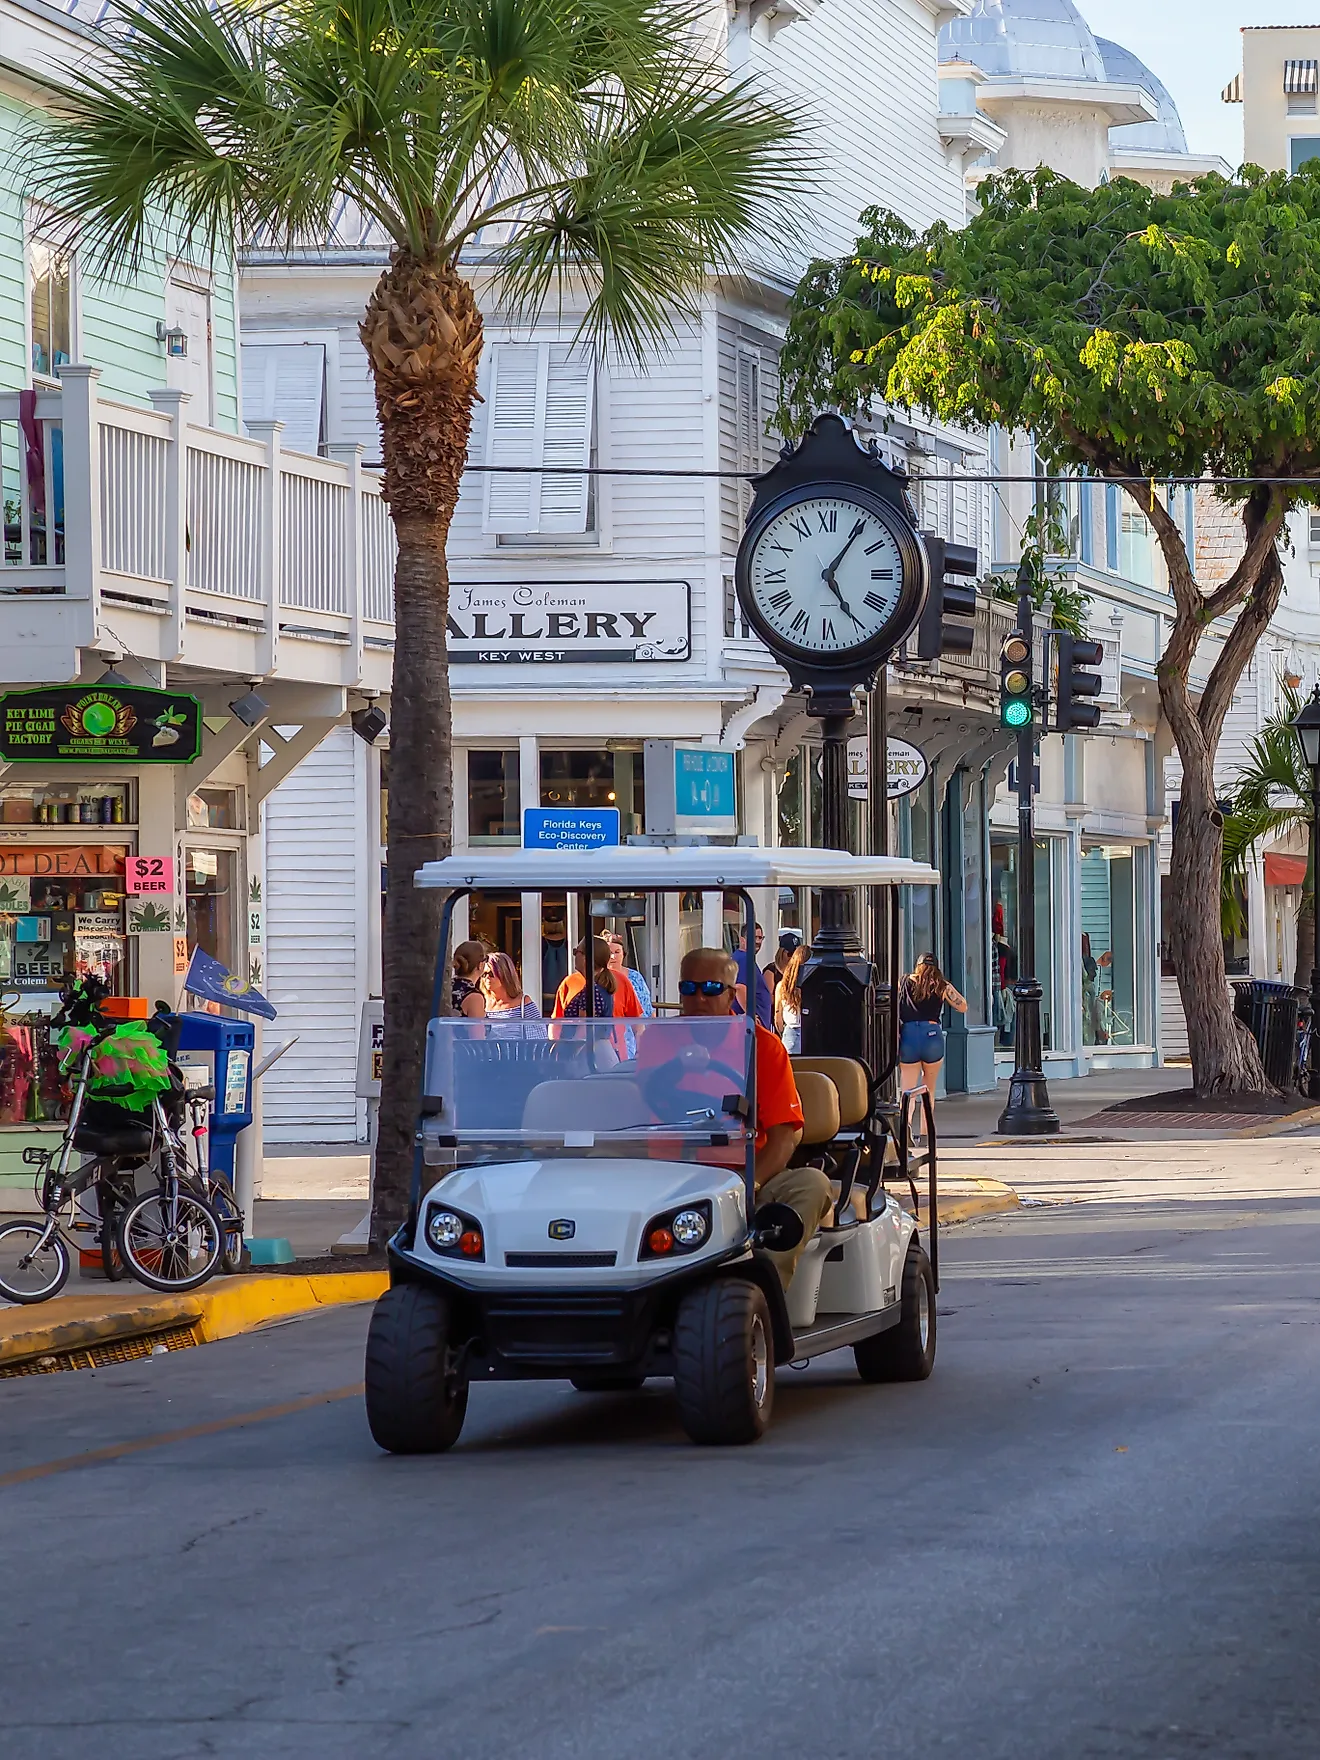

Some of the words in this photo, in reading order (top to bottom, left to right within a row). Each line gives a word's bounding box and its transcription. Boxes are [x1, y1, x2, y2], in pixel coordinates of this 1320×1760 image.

[788, 515, 813, 543] XI
[817, 510, 838, 533] XII
[770, 539, 794, 559] X
[863, 539, 886, 556] II
[870, 568, 894, 581] III
[457, 587, 507, 610] James
[513, 586, 587, 607] Coleman
[767, 589, 795, 617] VIII
[447, 612, 657, 639] ALLERY
[789, 608, 811, 636] VII
[478, 651, 511, 661] KEY
[517, 651, 566, 661] WEST
[76, 693, 98, 710] POINT
[6, 709, 27, 719] KEY
[28, 708, 55, 719] LIME
[5, 722, 22, 731] PIE
[25, 721, 56, 731] CIGAR
[8, 734, 53, 744] FACTORY
[543, 820, 576, 829] Florida
[579, 820, 602, 830] Keys
[539, 831, 606, 841] Eco-Discovery
[556, 842, 589, 850] Center
[135, 859, 164, 878] $2
[133, 881, 166, 891] BEER
[95, 916, 121, 926] Carry
[251, 913, 260, 930] $2
[27, 943, 49, 961] $2
[16, 962, 64, 976] BEER
